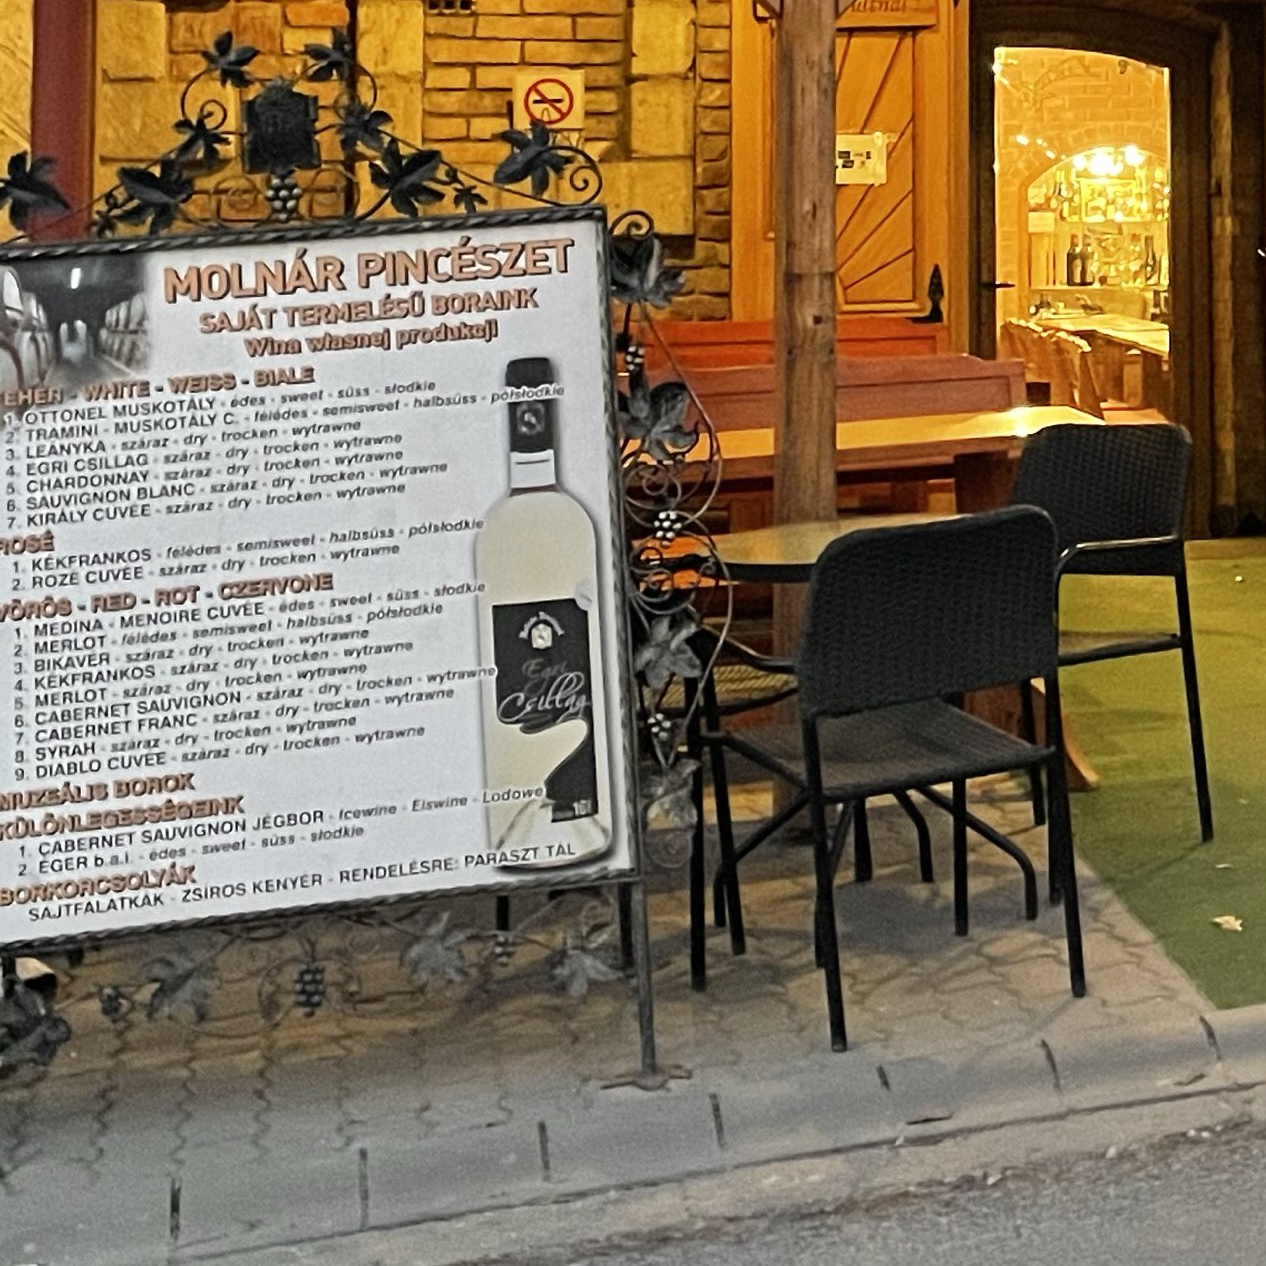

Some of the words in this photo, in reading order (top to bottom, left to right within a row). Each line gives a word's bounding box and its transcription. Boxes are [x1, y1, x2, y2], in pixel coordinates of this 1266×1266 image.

[163, 249, 345, 304] MOLNÁR
[357, 237, 575, 289] PINCÉSZET
[199, 303, 277, 334] SAJÁT
[430, 286, 538, 316] BORAINK
[243, 335, 302, 358] Wina
[85, 379, 150, 401] WHITE
[168, 372, 237, 394] WEISS
[24, 406, 107, 425] OTTONEL
[112, 395, 215, 418] MUSKOTÁLY
[24, 423, 98, 442] TRAMINI
[114, 411, 218, 434] MUSKOTÁLY
[182, 432, 208, 448] dry
[221, 427, 278, 442] trocken
[26, 459, 68, 476] EGRI
[73, 452, 148, 472] CSILLAG
[263, 440, 319, 456] trocken
[26, 469, 149, 494] CHARDONNAY
[263, 456, 320, 472] trocken
[26, 487, 131, 510] SAUVIGNON
[136, 482, 195, 500] BLANC
[309, 469, 365, 485] trocken
[227, 496, 252, 510] dry
[265, 490, 322, 505] trocken
[259, 551, 316, 567] trocken
[90, 591, 137, 614] RED
[154, 584, 200, 607] ROT
[33, 617, 103, 637] MEDINA
[34, 633, 107, 654] MERLOT
[227, 636, 284, 652] trocken
[271, 649, 328, 665] trocken
[34, 687, 107, 708] MERLOT
[224, 671, 282, 688] trocken
[34, 701, 131, 726] CABERNET
[136, 690, 241, 715] SAUVIGNON
[318, 682, 342, 696] dry
[356, 675, 412, 691] trocken
[34, 719, 132, 743] CABERNET
[137, 712, 197, 733] FRANC
[275, 703, 299, 718] dry
[313, 697, 369, 713] trocken
[35, 740, 95, 761] SYRAH
[213, 725, 271, 741] trocken
[35, 758, 101, 779] DIABLO
[283, 735, 340, 751] trocken
[112, 771, 195, 799] BOROK
[38, 830, 136, 857] CABERNET
[141, 817, 246, 844] SAUVIGNON
[464, 846, 539, 868] PARASZT
